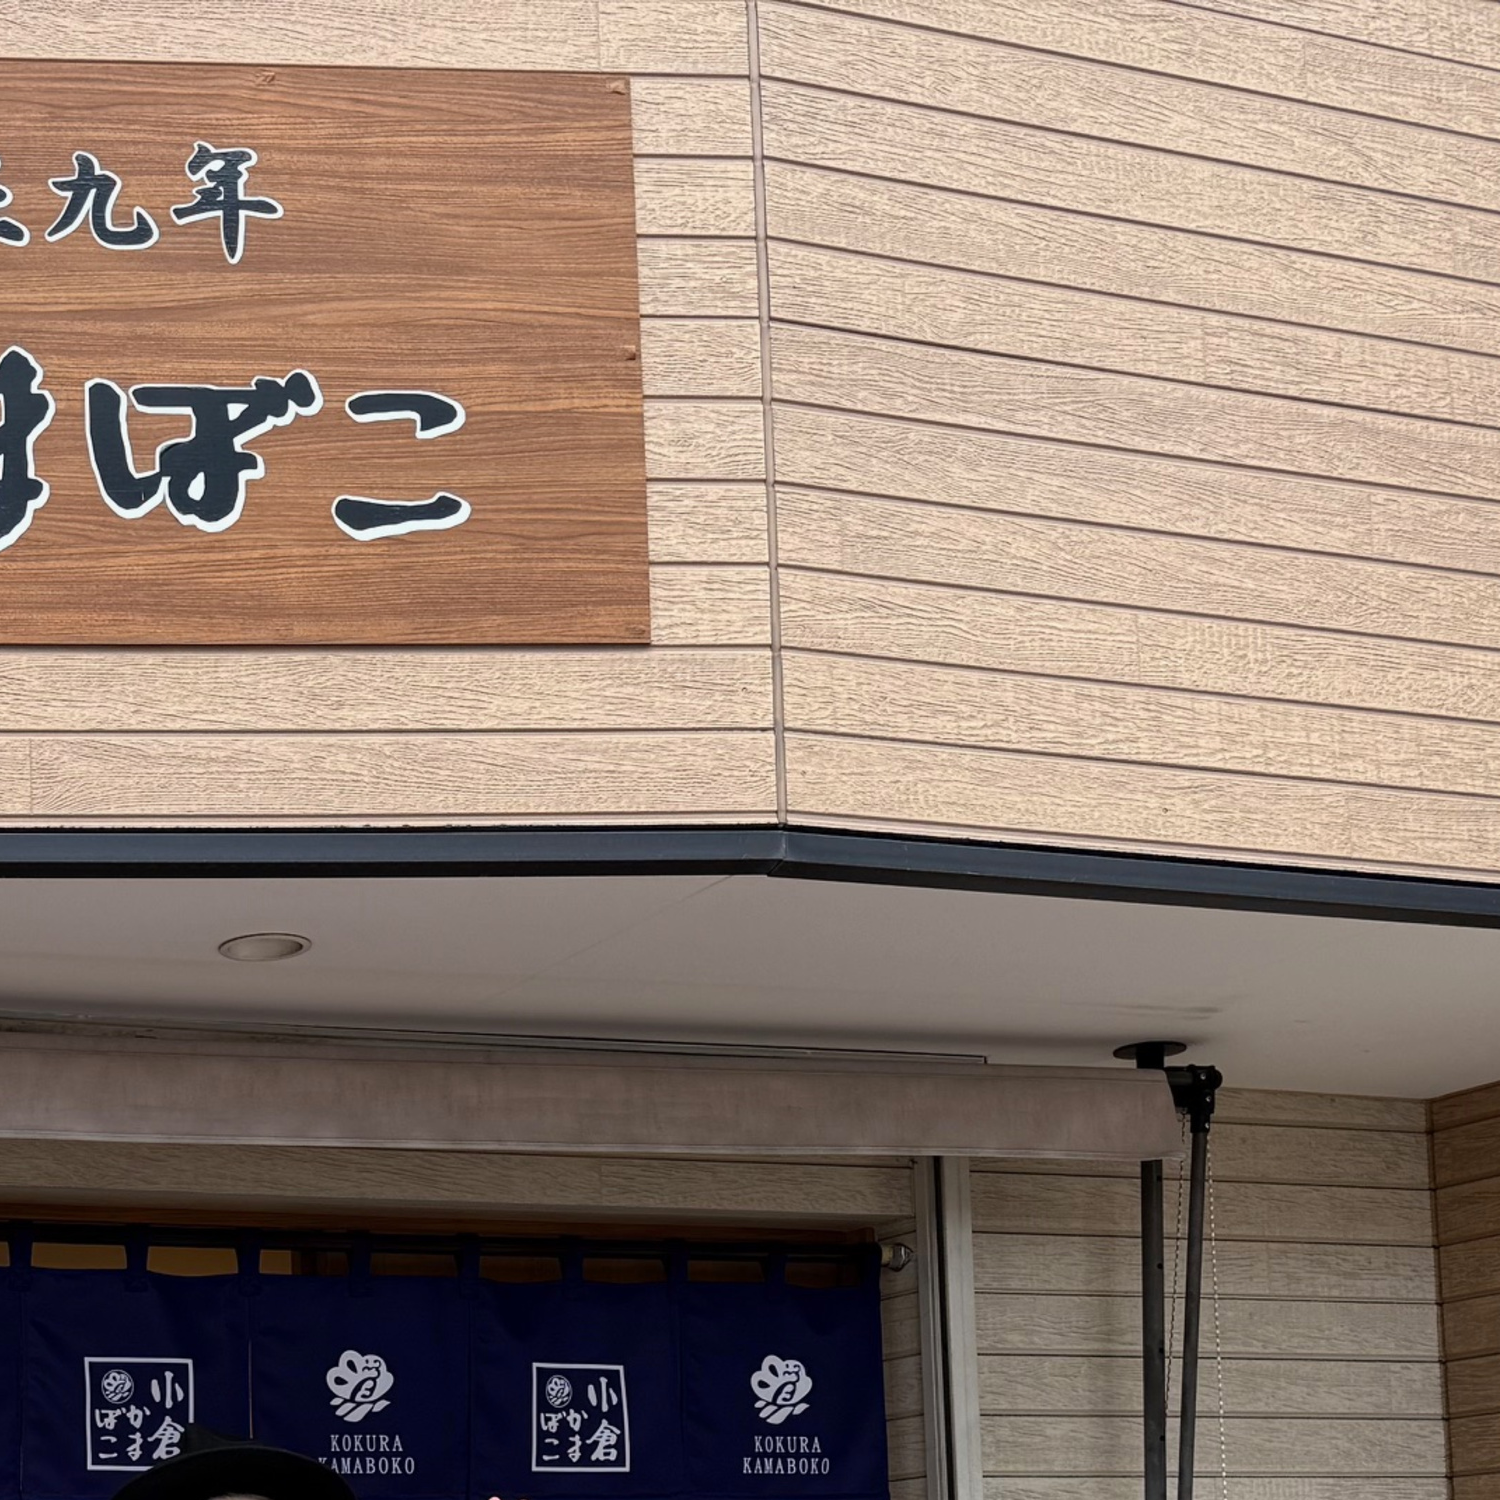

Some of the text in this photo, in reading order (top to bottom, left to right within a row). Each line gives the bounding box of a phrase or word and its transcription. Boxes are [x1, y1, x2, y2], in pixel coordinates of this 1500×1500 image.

[330, 1434, 404, 1452] KOKURA
[754, 1435, 821, 1453] KOKURA
[742, 1457, 830, 1475] KAMABOKO
